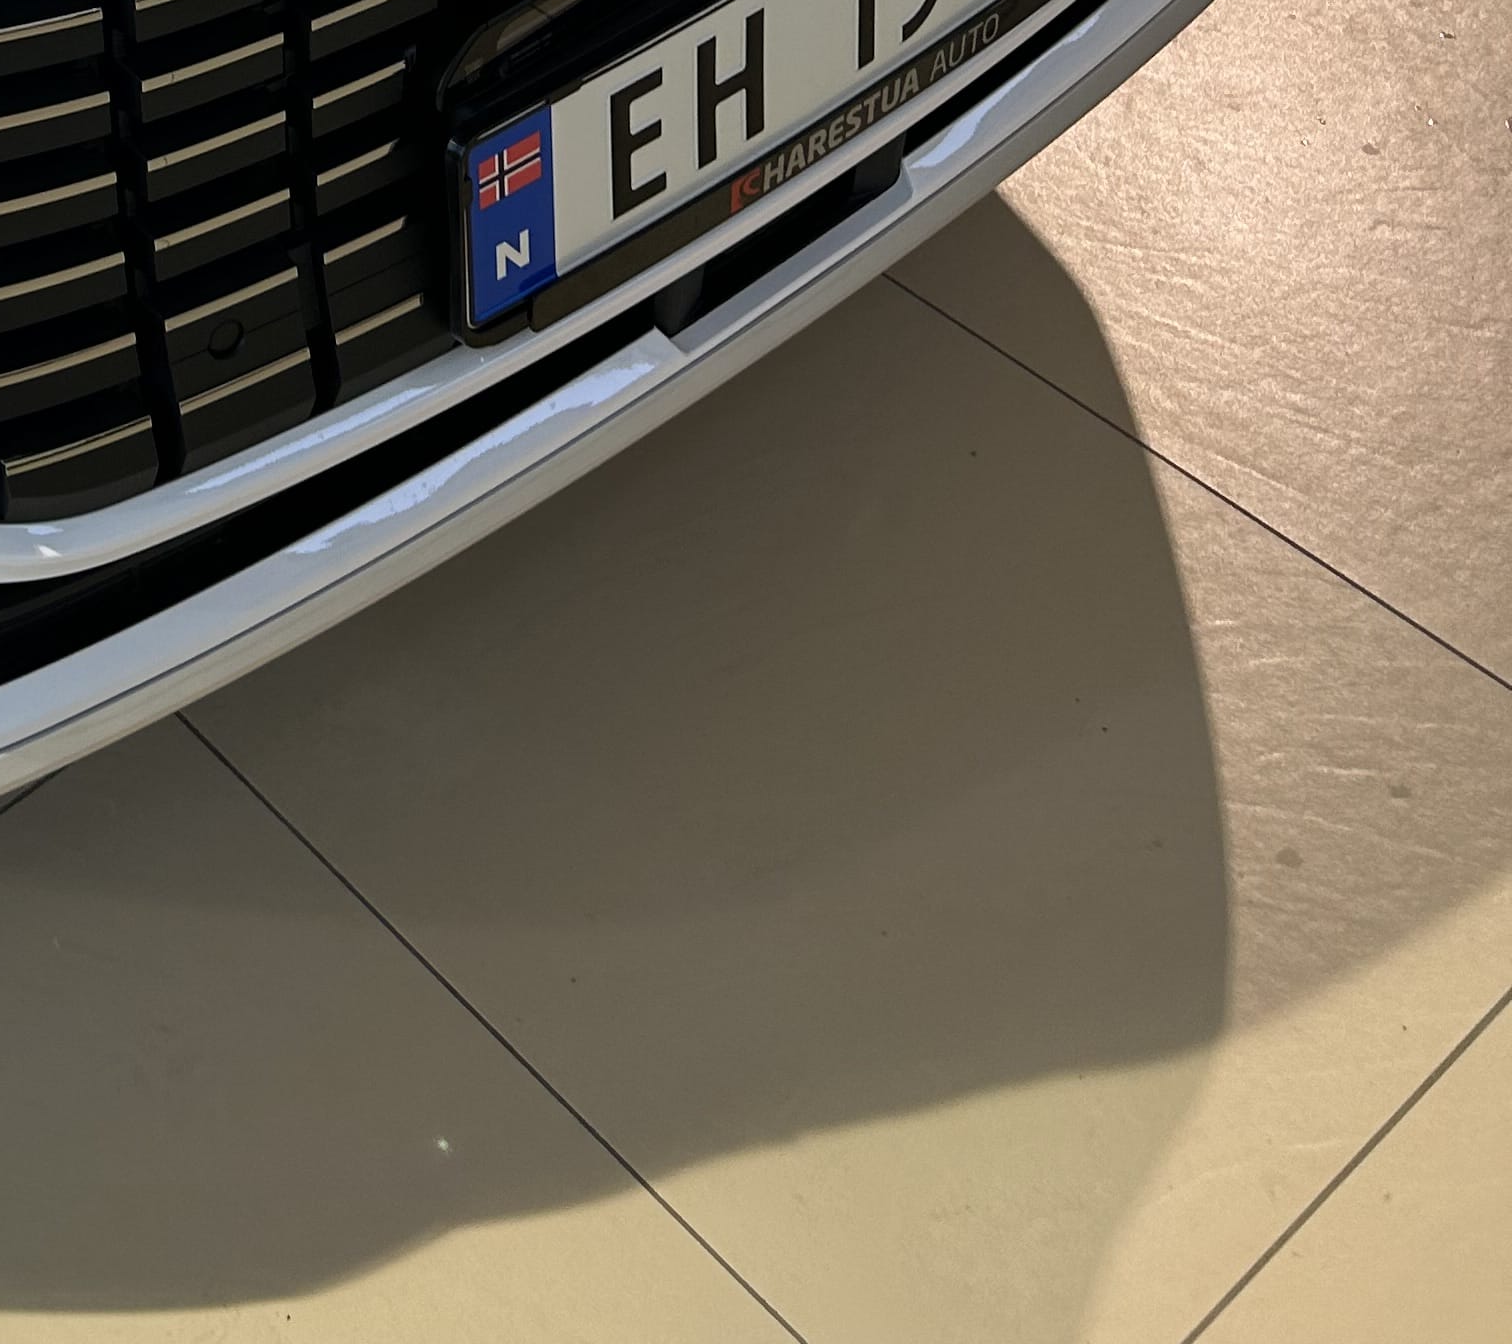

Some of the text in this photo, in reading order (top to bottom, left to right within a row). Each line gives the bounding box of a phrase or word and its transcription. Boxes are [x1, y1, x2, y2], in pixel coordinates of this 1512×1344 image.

[609, 6, 766, 221] EH
[762, 13, 1000, 193] HARESTUA AUTO
[495, 229, 531, 282] N
